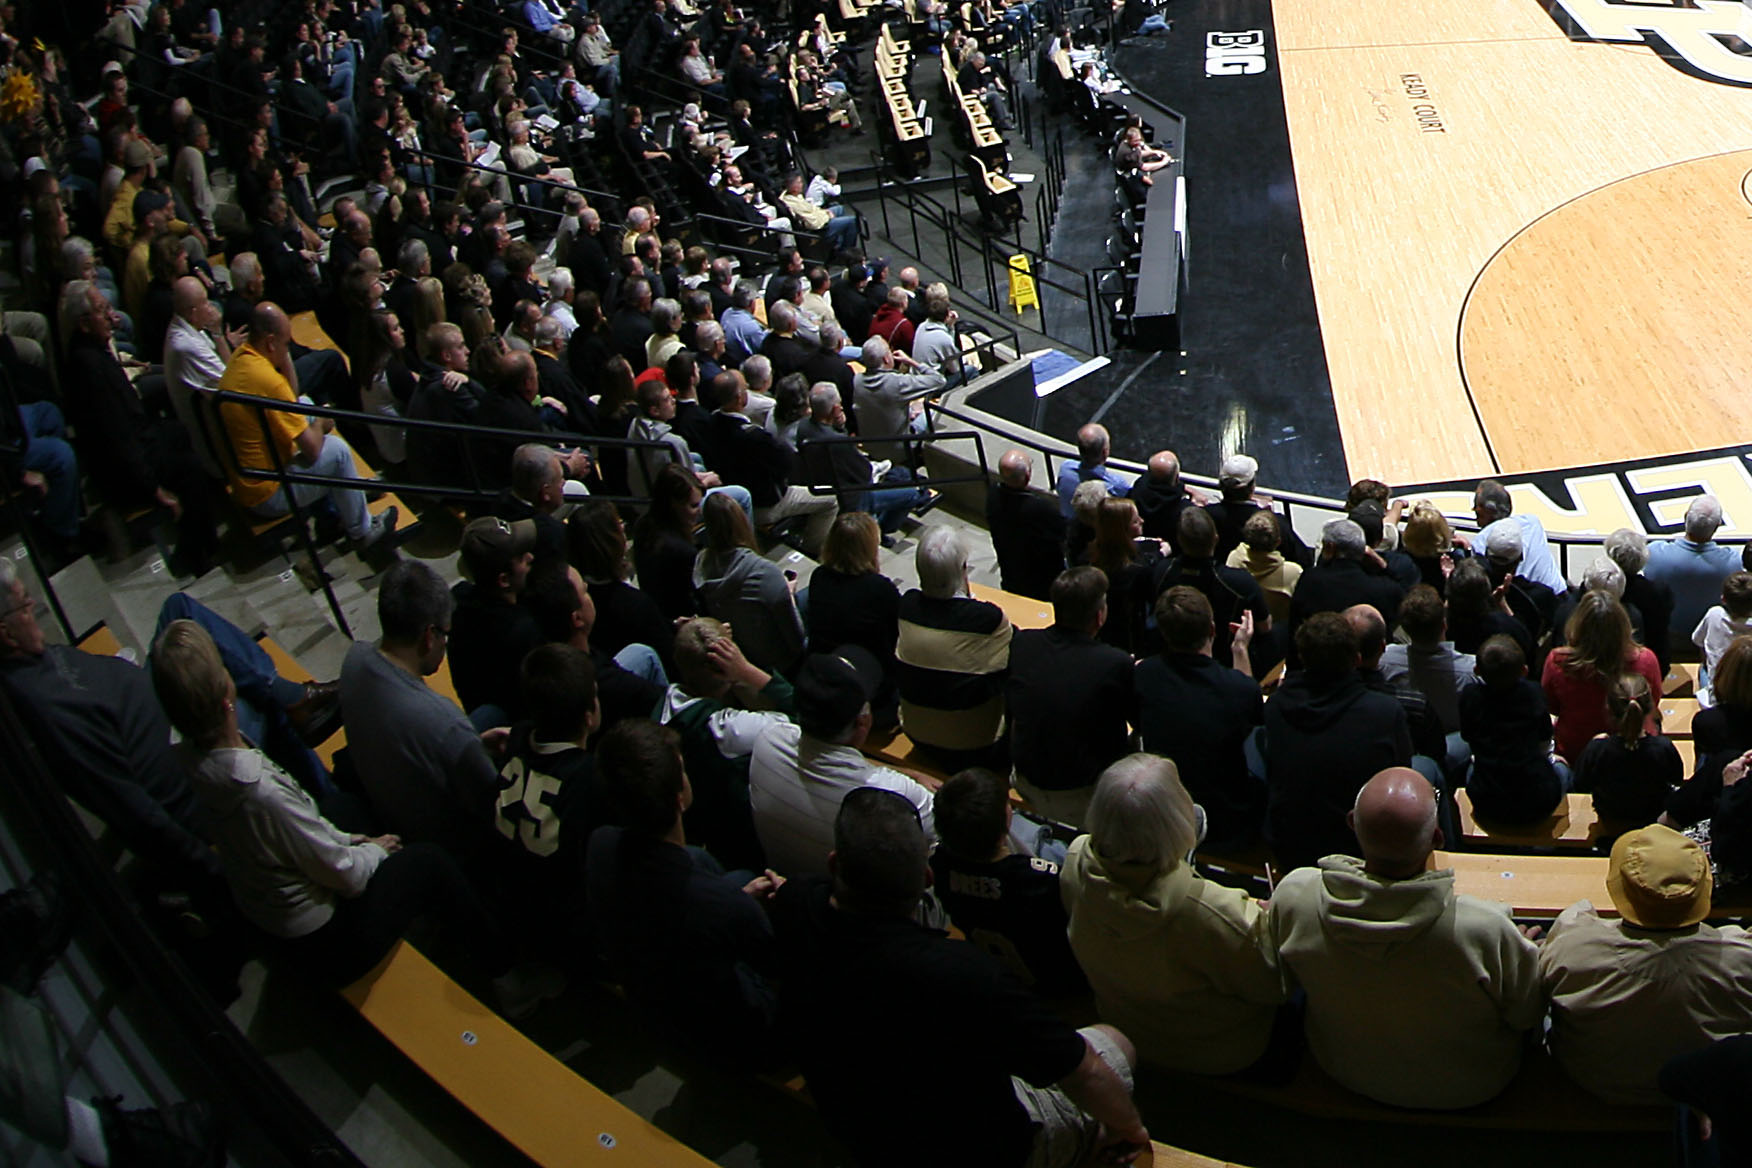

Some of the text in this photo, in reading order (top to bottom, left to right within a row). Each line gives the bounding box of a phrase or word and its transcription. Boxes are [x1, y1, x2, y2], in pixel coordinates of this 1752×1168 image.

[1399, 73, 1446, 133] KEADY COURT
[493, 754, 564, 859] 25
